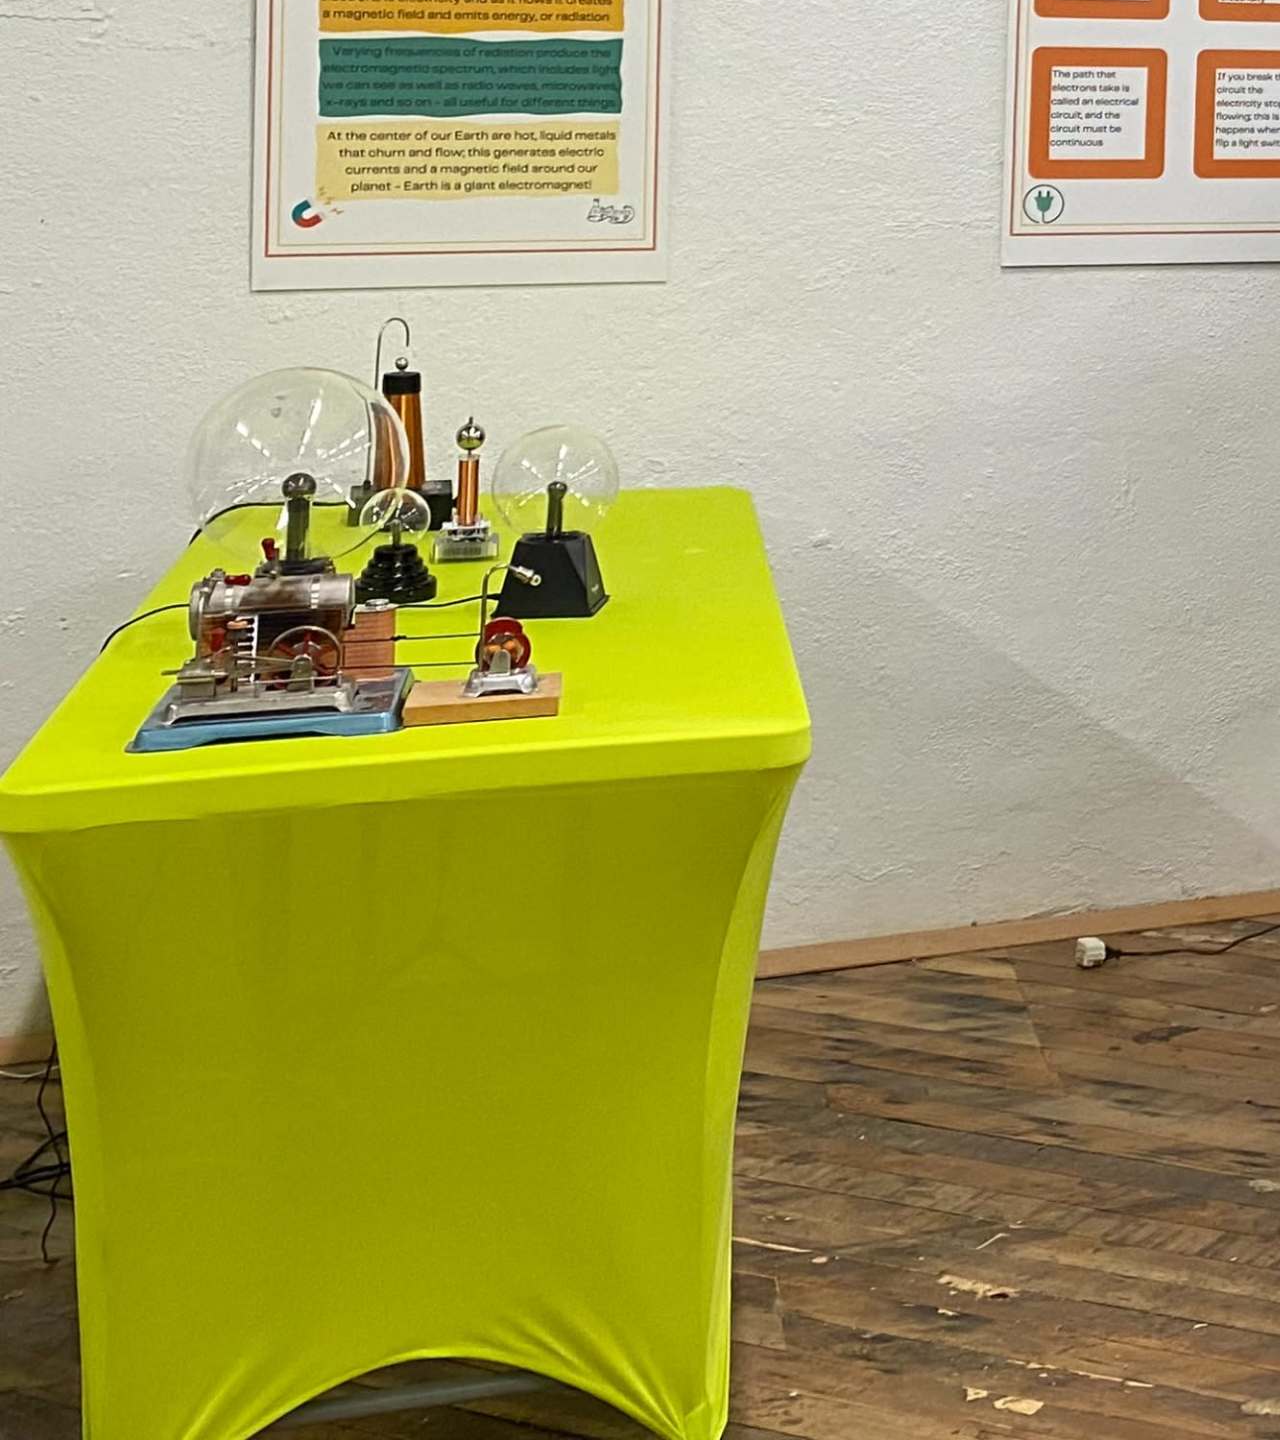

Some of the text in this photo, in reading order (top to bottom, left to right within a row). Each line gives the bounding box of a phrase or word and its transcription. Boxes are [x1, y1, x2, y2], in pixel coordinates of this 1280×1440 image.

[333, 9, 394, 21] magnetic
[398, 9, 425, 19] field
[428, 10, 451, 20] and
[455, 11, 490, 20] emits
[540, 13, 553, 21] or
[556, 12, 610, 21] radiation
[327, 132, 342, 141] At
[346, 132, 367, 141] the
[370, 132, 412, 141] center
[415, 131, 428, 141] of
[431, 133, 452, 141] our
[455, 131, 488, 141] Earth
[491, 133, 511, 141] are
[540, 131, 572, 143] liquid
[575, 131, 616, 141] metals
[339, 148, 365, 158] that
[369, 149, 405, 158] churn
[409, 148, 432, 158] and
[468, 148, 491, 157] this
[494, 149, 556, 160] generates
[559, 148, 604, 157] electric
[345, 165, 400, 175] currents
[404, 165, 427, 174] and
[440, 165, 499, 176] magnetic
[503, 164, 528, 174] field
[532, 164, 574, 174] around
[577, 165, 598, 173] our
[351, 182, 391, 193] planet
[404, 181, 437, 191] Earth
[441, 181, 451, 191] is
[464, 181, 495, 193] giant
